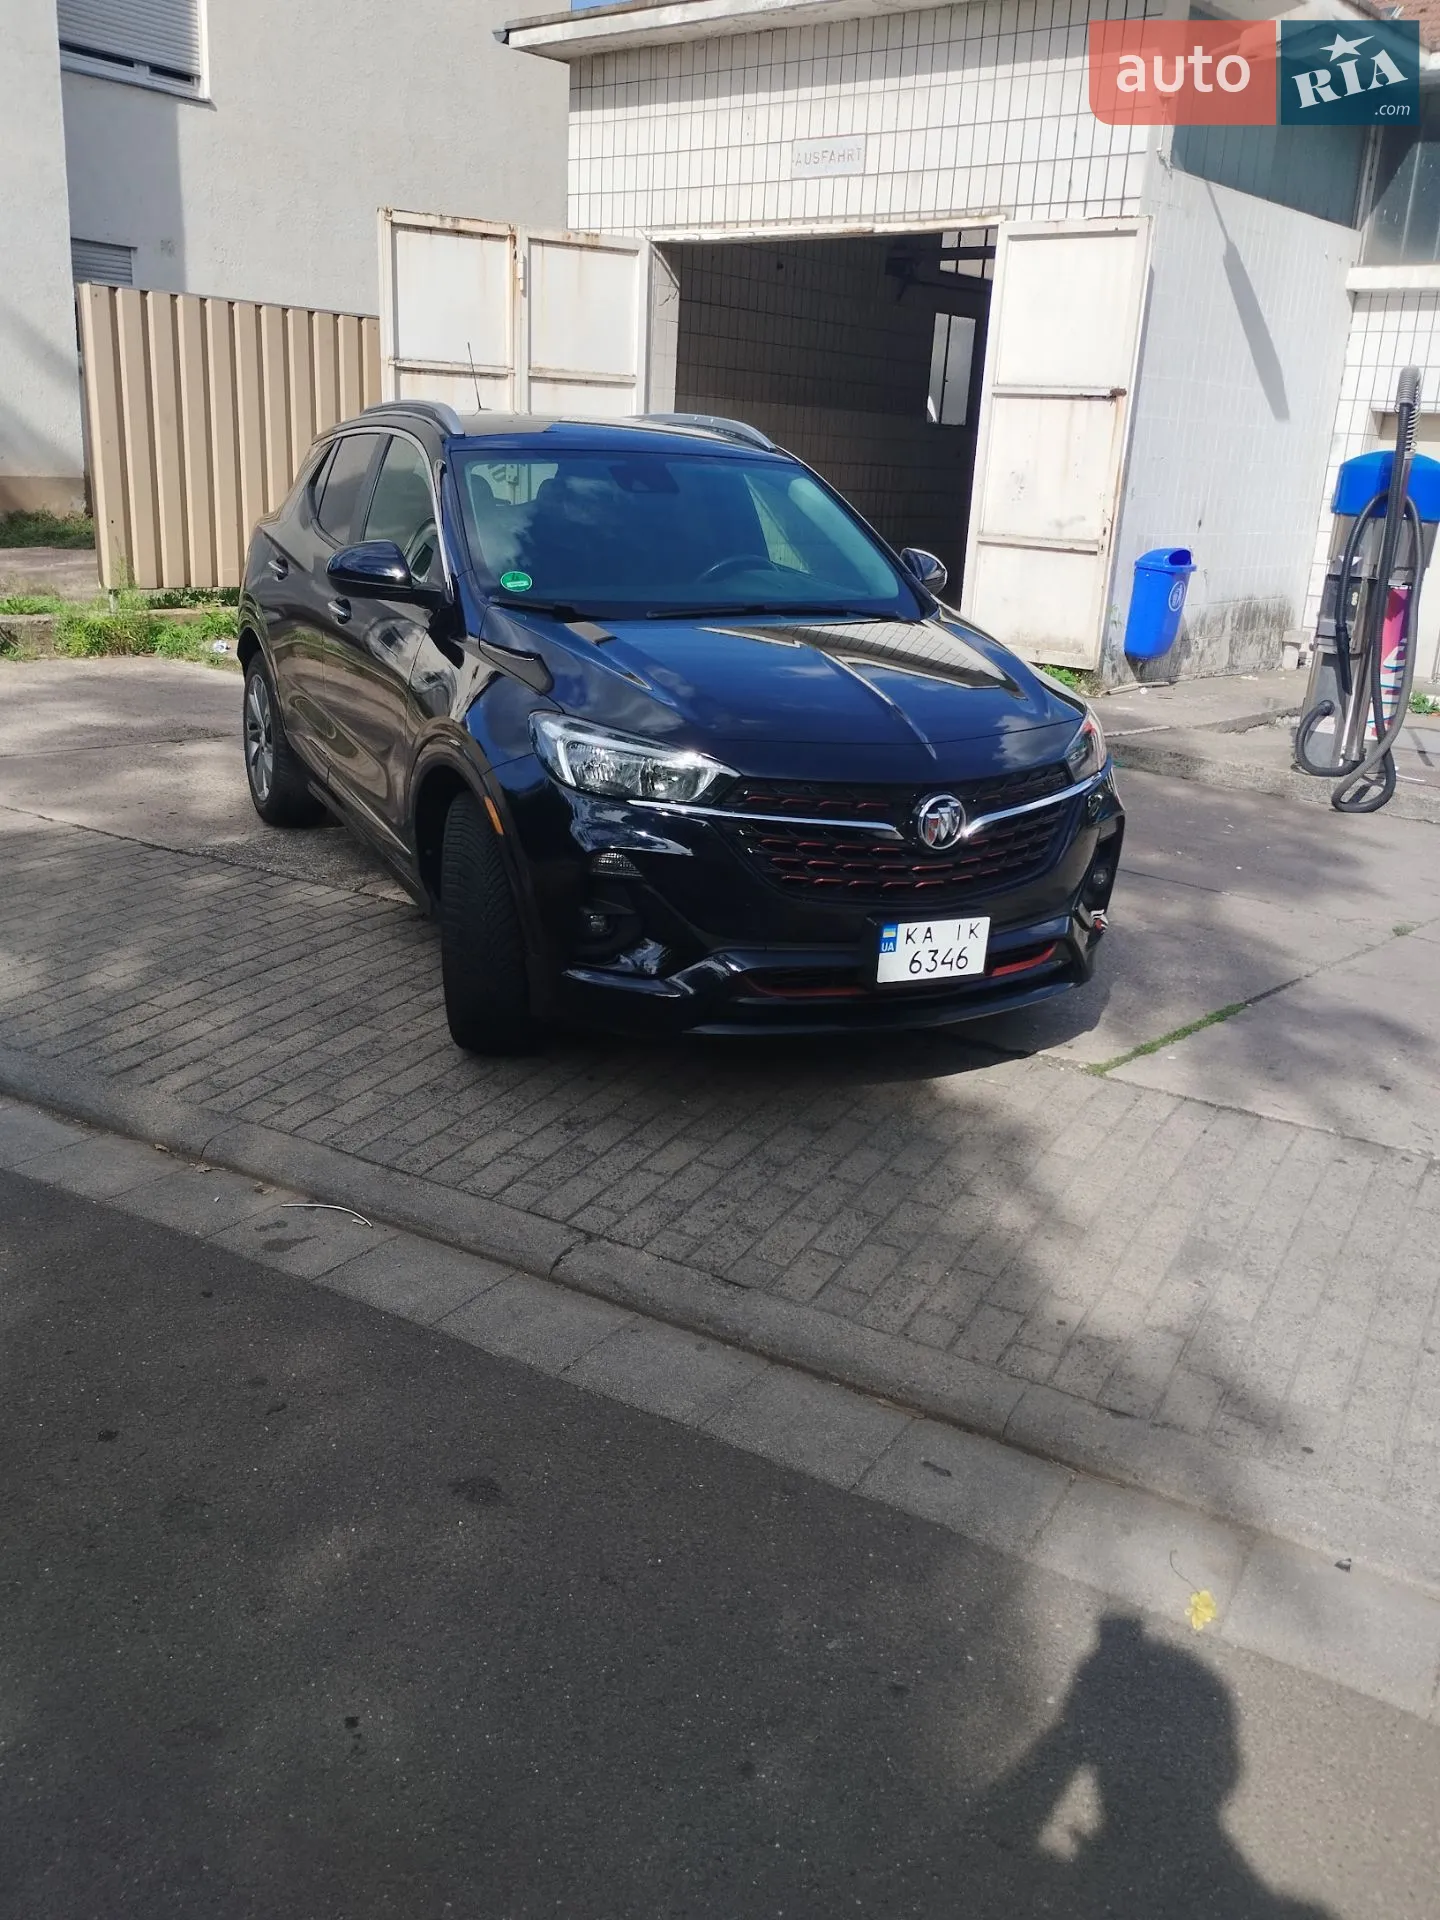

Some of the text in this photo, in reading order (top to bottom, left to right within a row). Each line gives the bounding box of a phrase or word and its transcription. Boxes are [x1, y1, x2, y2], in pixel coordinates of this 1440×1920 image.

[795, 147, 862, 166] AUSFAHRT
[905, 922, 981, 945] KA IK
[881, 941, 895, 952] UA
[908, 946, 969, 974] 6346
